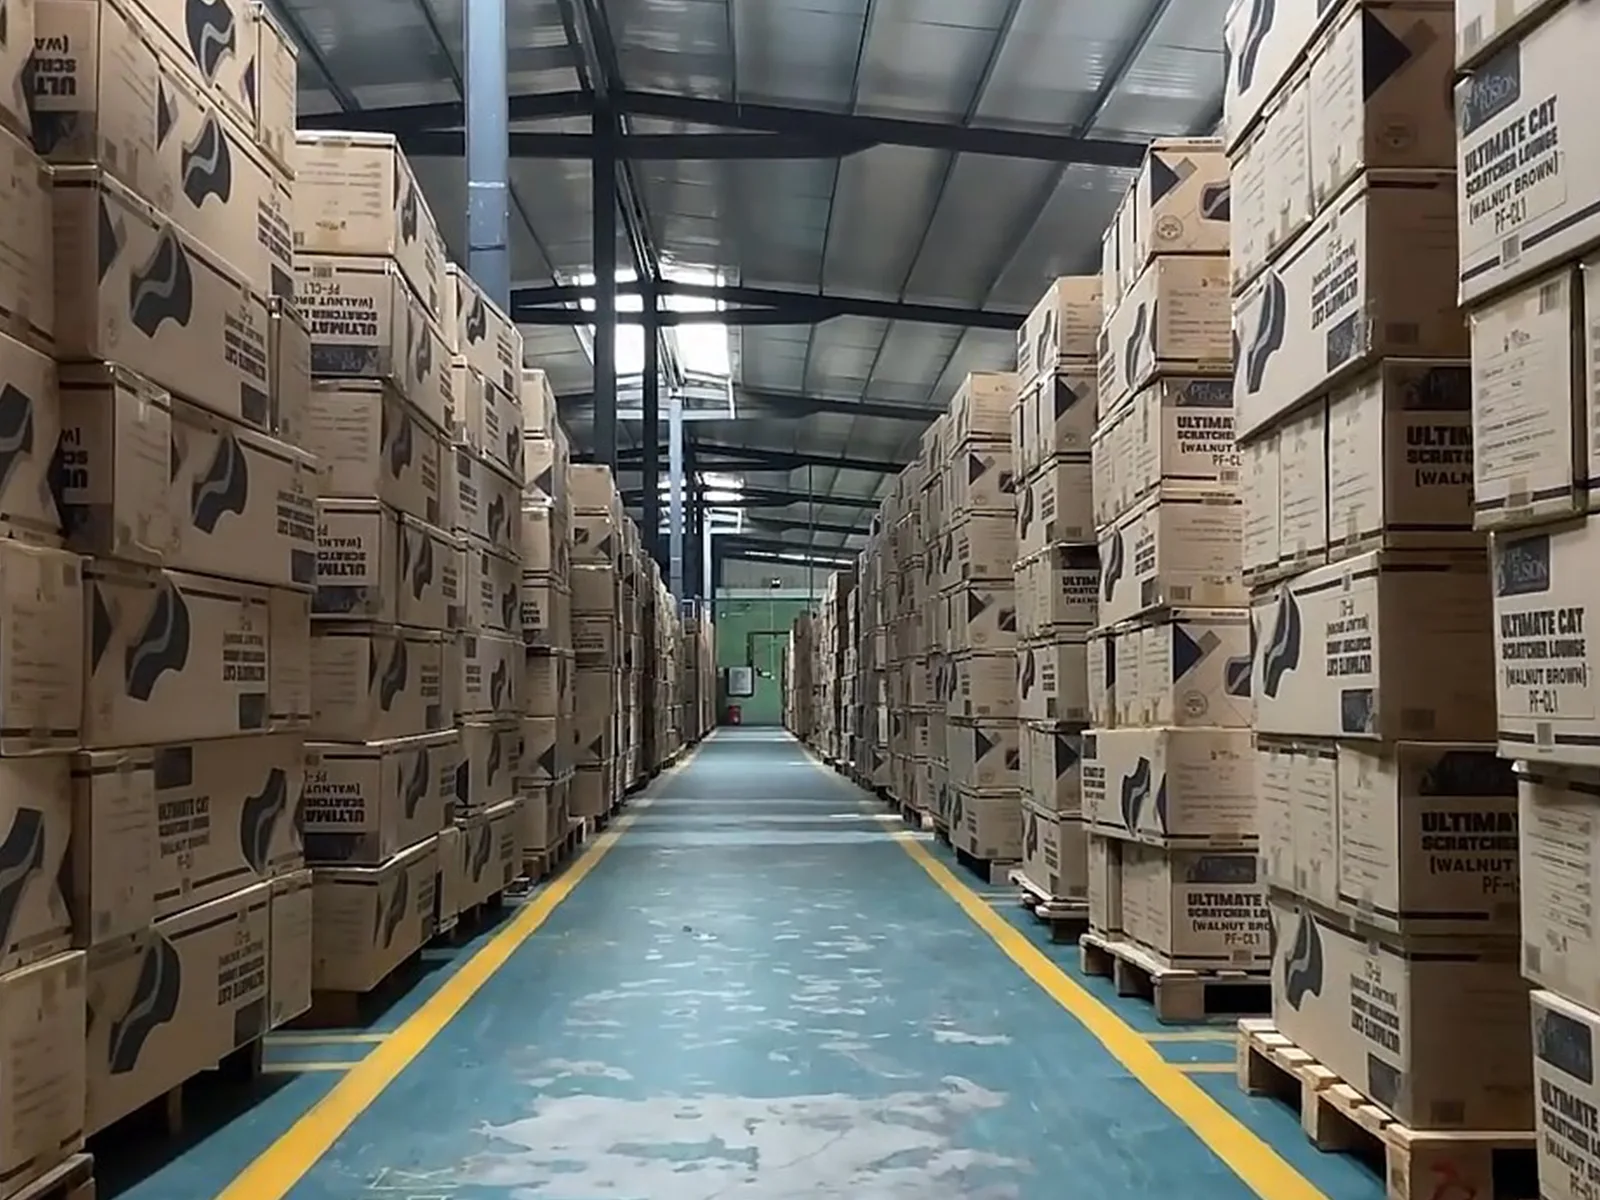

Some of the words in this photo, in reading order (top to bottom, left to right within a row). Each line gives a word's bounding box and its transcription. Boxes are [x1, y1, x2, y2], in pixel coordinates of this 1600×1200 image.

[1465, 116, 1526, 178] ULTIMATE
[1529, 94, 1558, 136] CAT
[1466, 153, 1517, 199] SCRATCHER
[1518, 127, 1558, 168] LOUNGE
[1515, 151, 1558, 195] BROWN)
[303, 283, 340, 295] PF-CL1
[1176, 416, 1234, 429] ULTIMA
[1501, 609, 1555, 638] ULTIMATE
[1558, 608, 1584, 634] CAT
[1502, 641, 1548, 660] SCRATCHER
[1549, 639, 1586, 660] LOUNGE
[1187, 893, 1261, 906] ULTIMATE
[1188, 908, 1251, 918] SCRATCHER
[1193, 920, 1244, 933] (WALNUT
